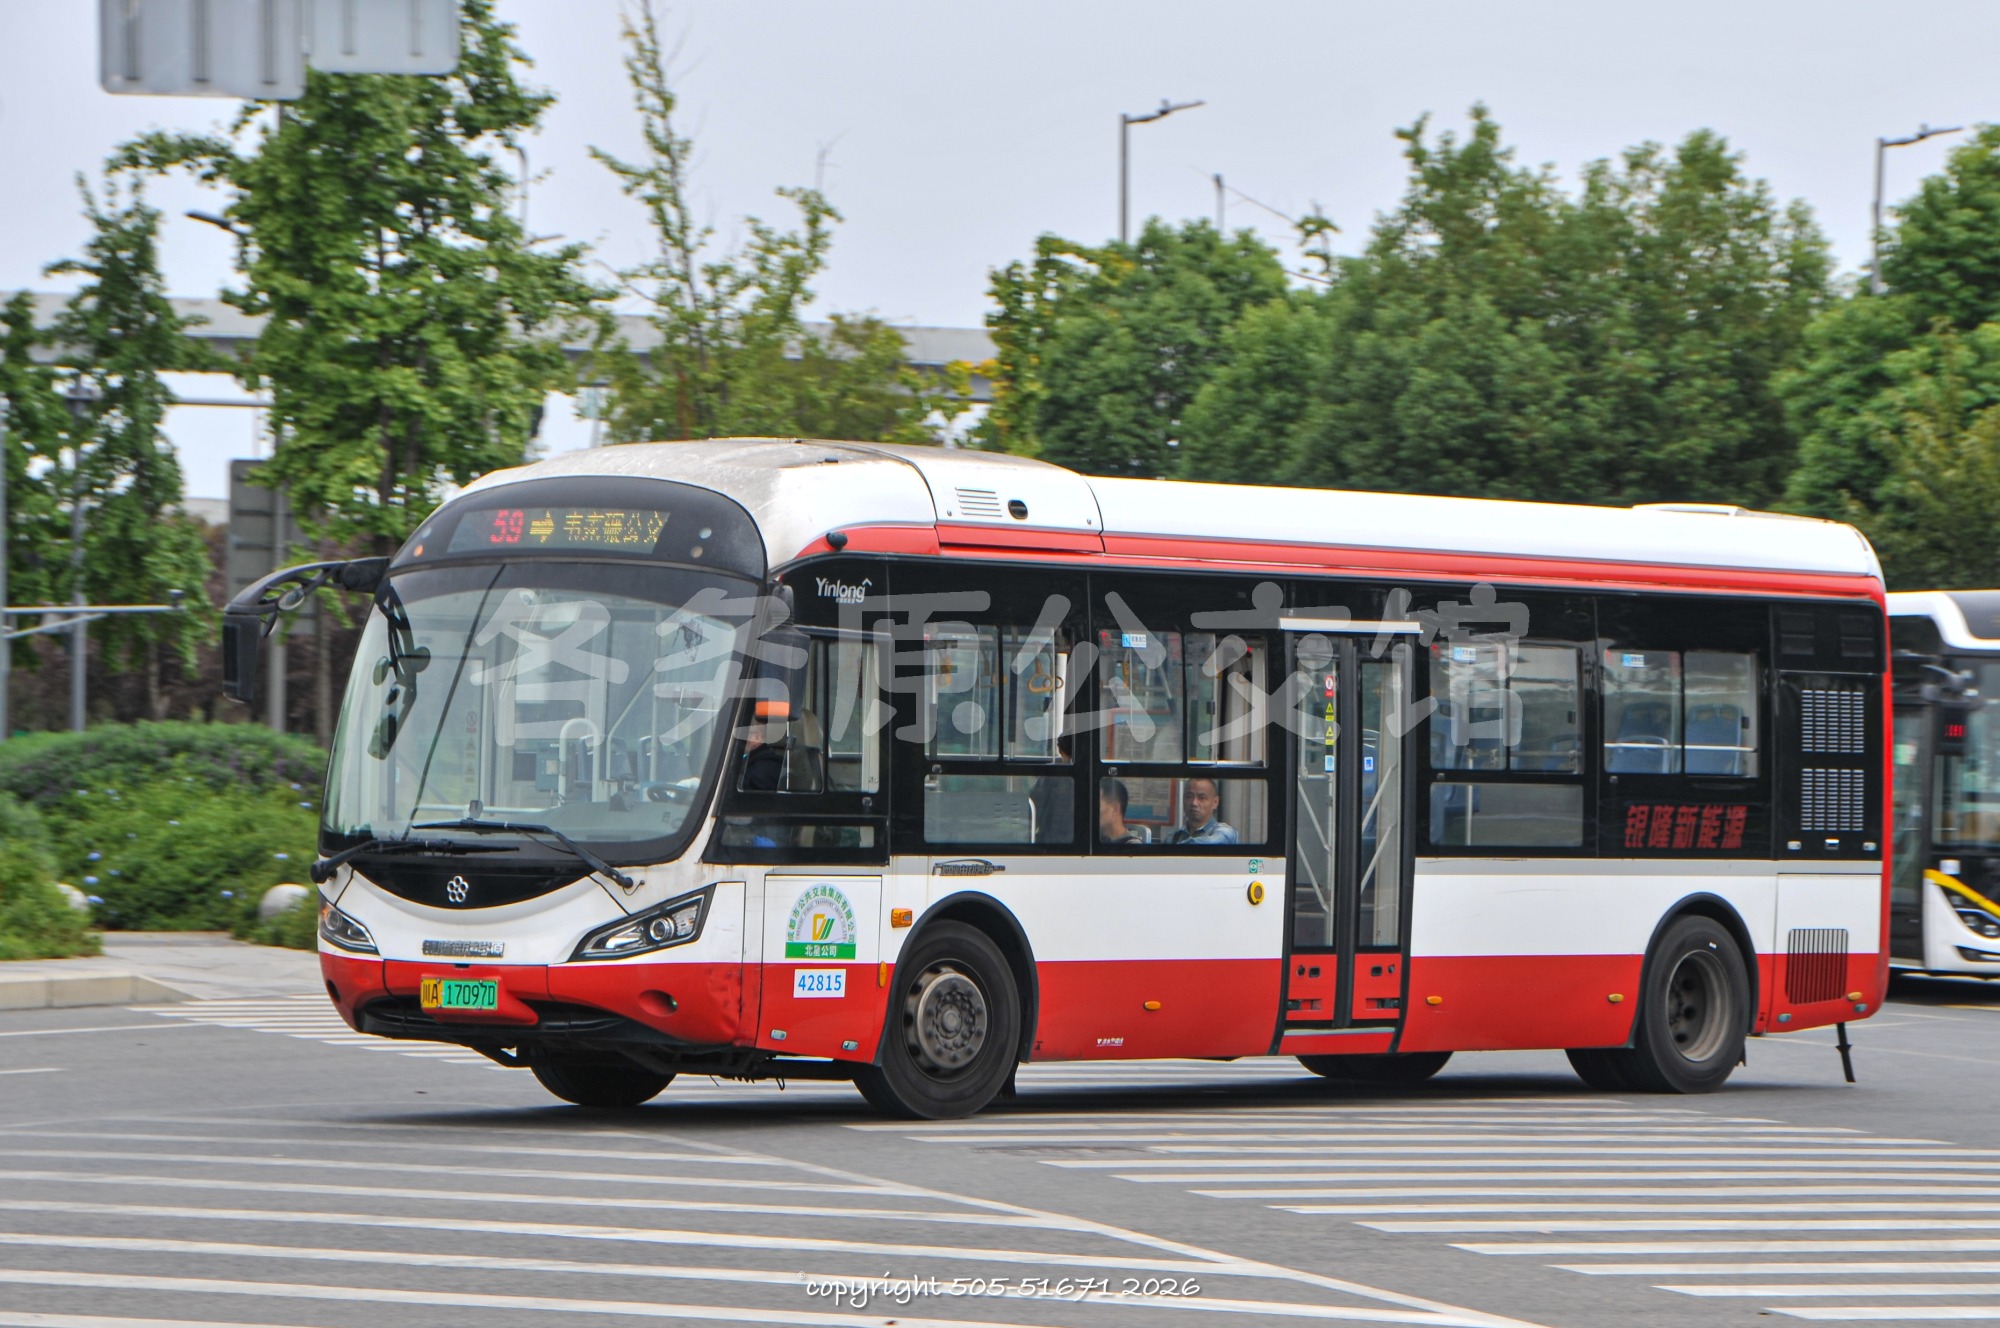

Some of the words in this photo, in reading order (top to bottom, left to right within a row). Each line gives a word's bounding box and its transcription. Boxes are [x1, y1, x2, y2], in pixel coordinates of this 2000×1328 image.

[490, 509, 524, 544] 59
[815, 577, 866, 603] Yinlong
[1624, 804, 1748, 849] 银隆新能源
[787, 885, 855, 943] 成都市公共交通集团有限公司
[798, 974, 842, 991] 42815
